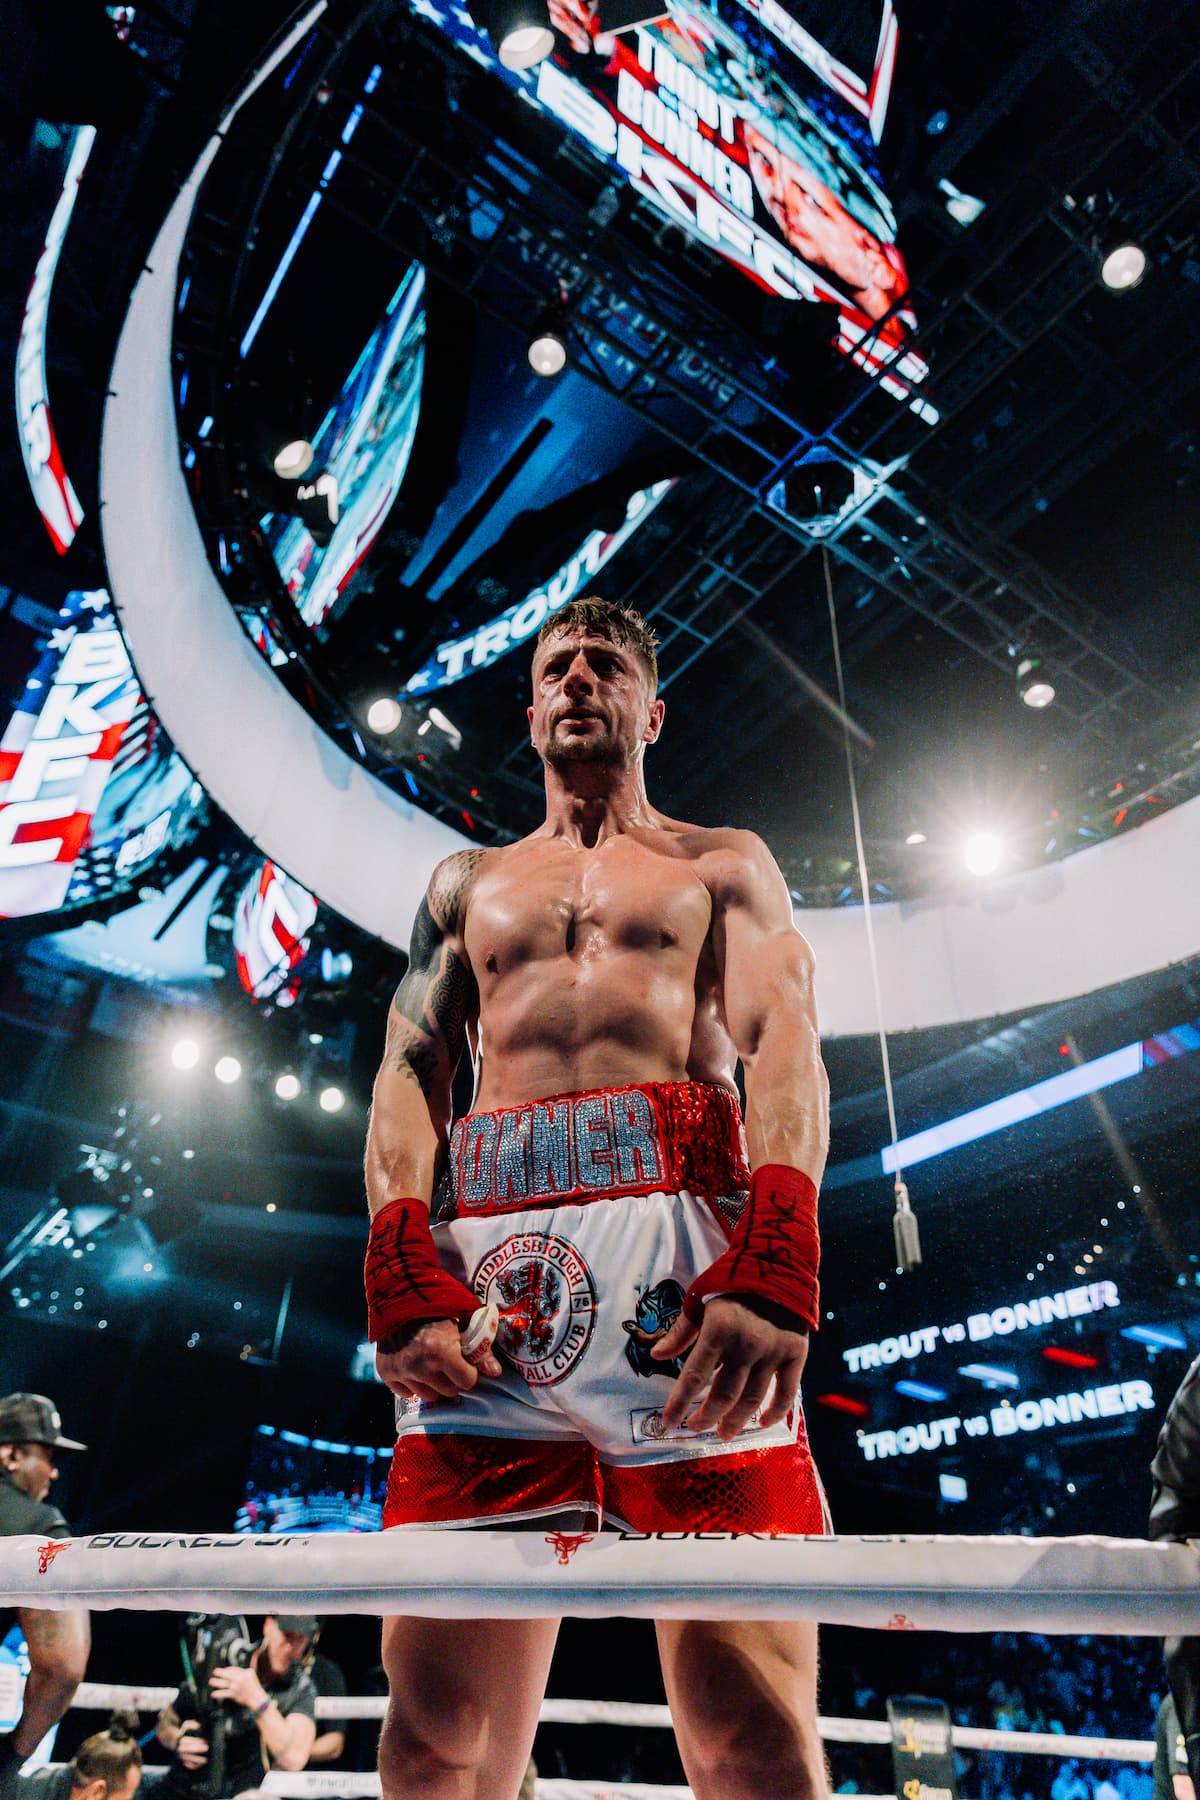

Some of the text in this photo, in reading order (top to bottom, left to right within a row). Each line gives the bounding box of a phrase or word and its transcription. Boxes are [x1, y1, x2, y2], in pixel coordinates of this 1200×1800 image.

[536, 60, 816, 301] BKFC
[437, 529, 607, 679] TROUT
[0, 630, 132, 868] BKFC
[553, 1324, 586, 1370] CLUB
[843, 1326, 940, 1373] TROUT
[967, 1280, 1120, 1342] BONNER
[858, 1416, 961, 1461] TROUT
[990, 1380, 1155, 1437] BONNER
